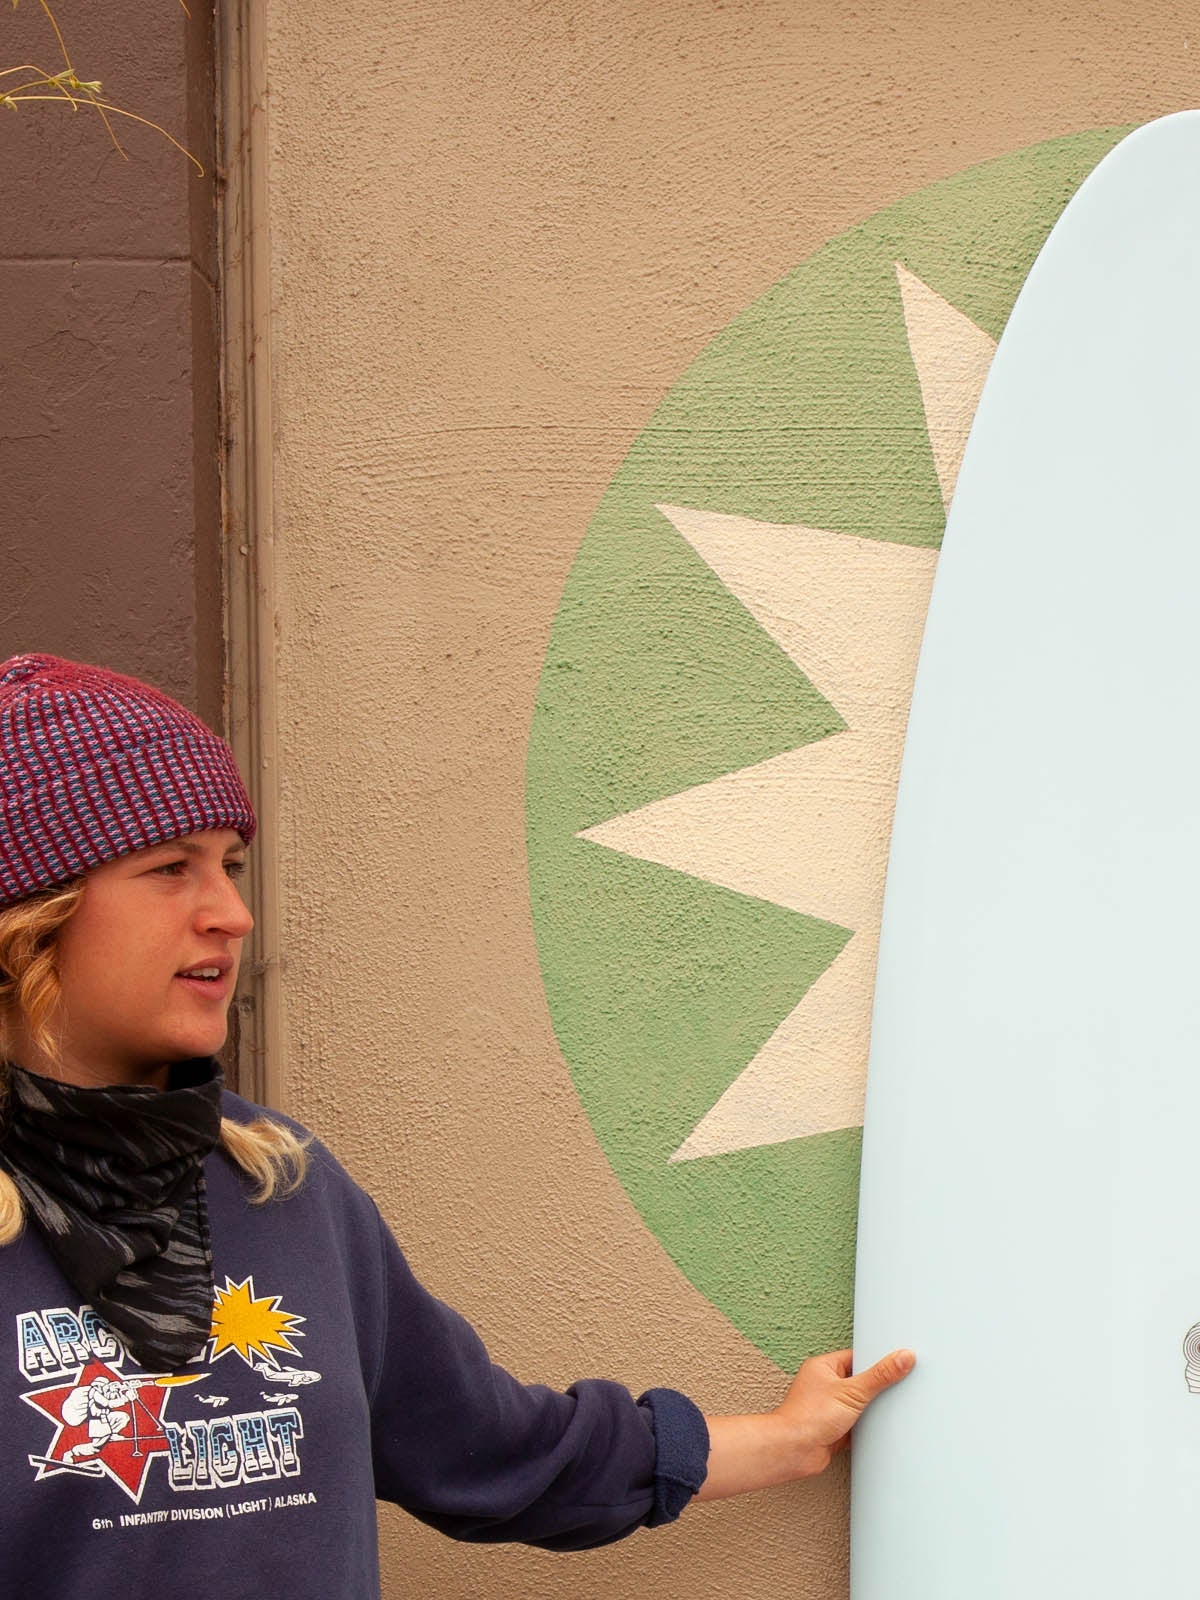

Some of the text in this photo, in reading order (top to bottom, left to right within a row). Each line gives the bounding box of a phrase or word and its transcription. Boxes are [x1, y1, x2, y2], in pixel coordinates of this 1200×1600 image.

[16, 1305, 142, 1383] ARC
[164, 1407, 304, 1492] LIGHT
[92, 1518, 113, 1529] 6th
[120, 1510, 170, 1527] INFANTRY
[171, 1507, 223, 1521] DIVISION
[274, 1492, 317, 1509] ALASKA
